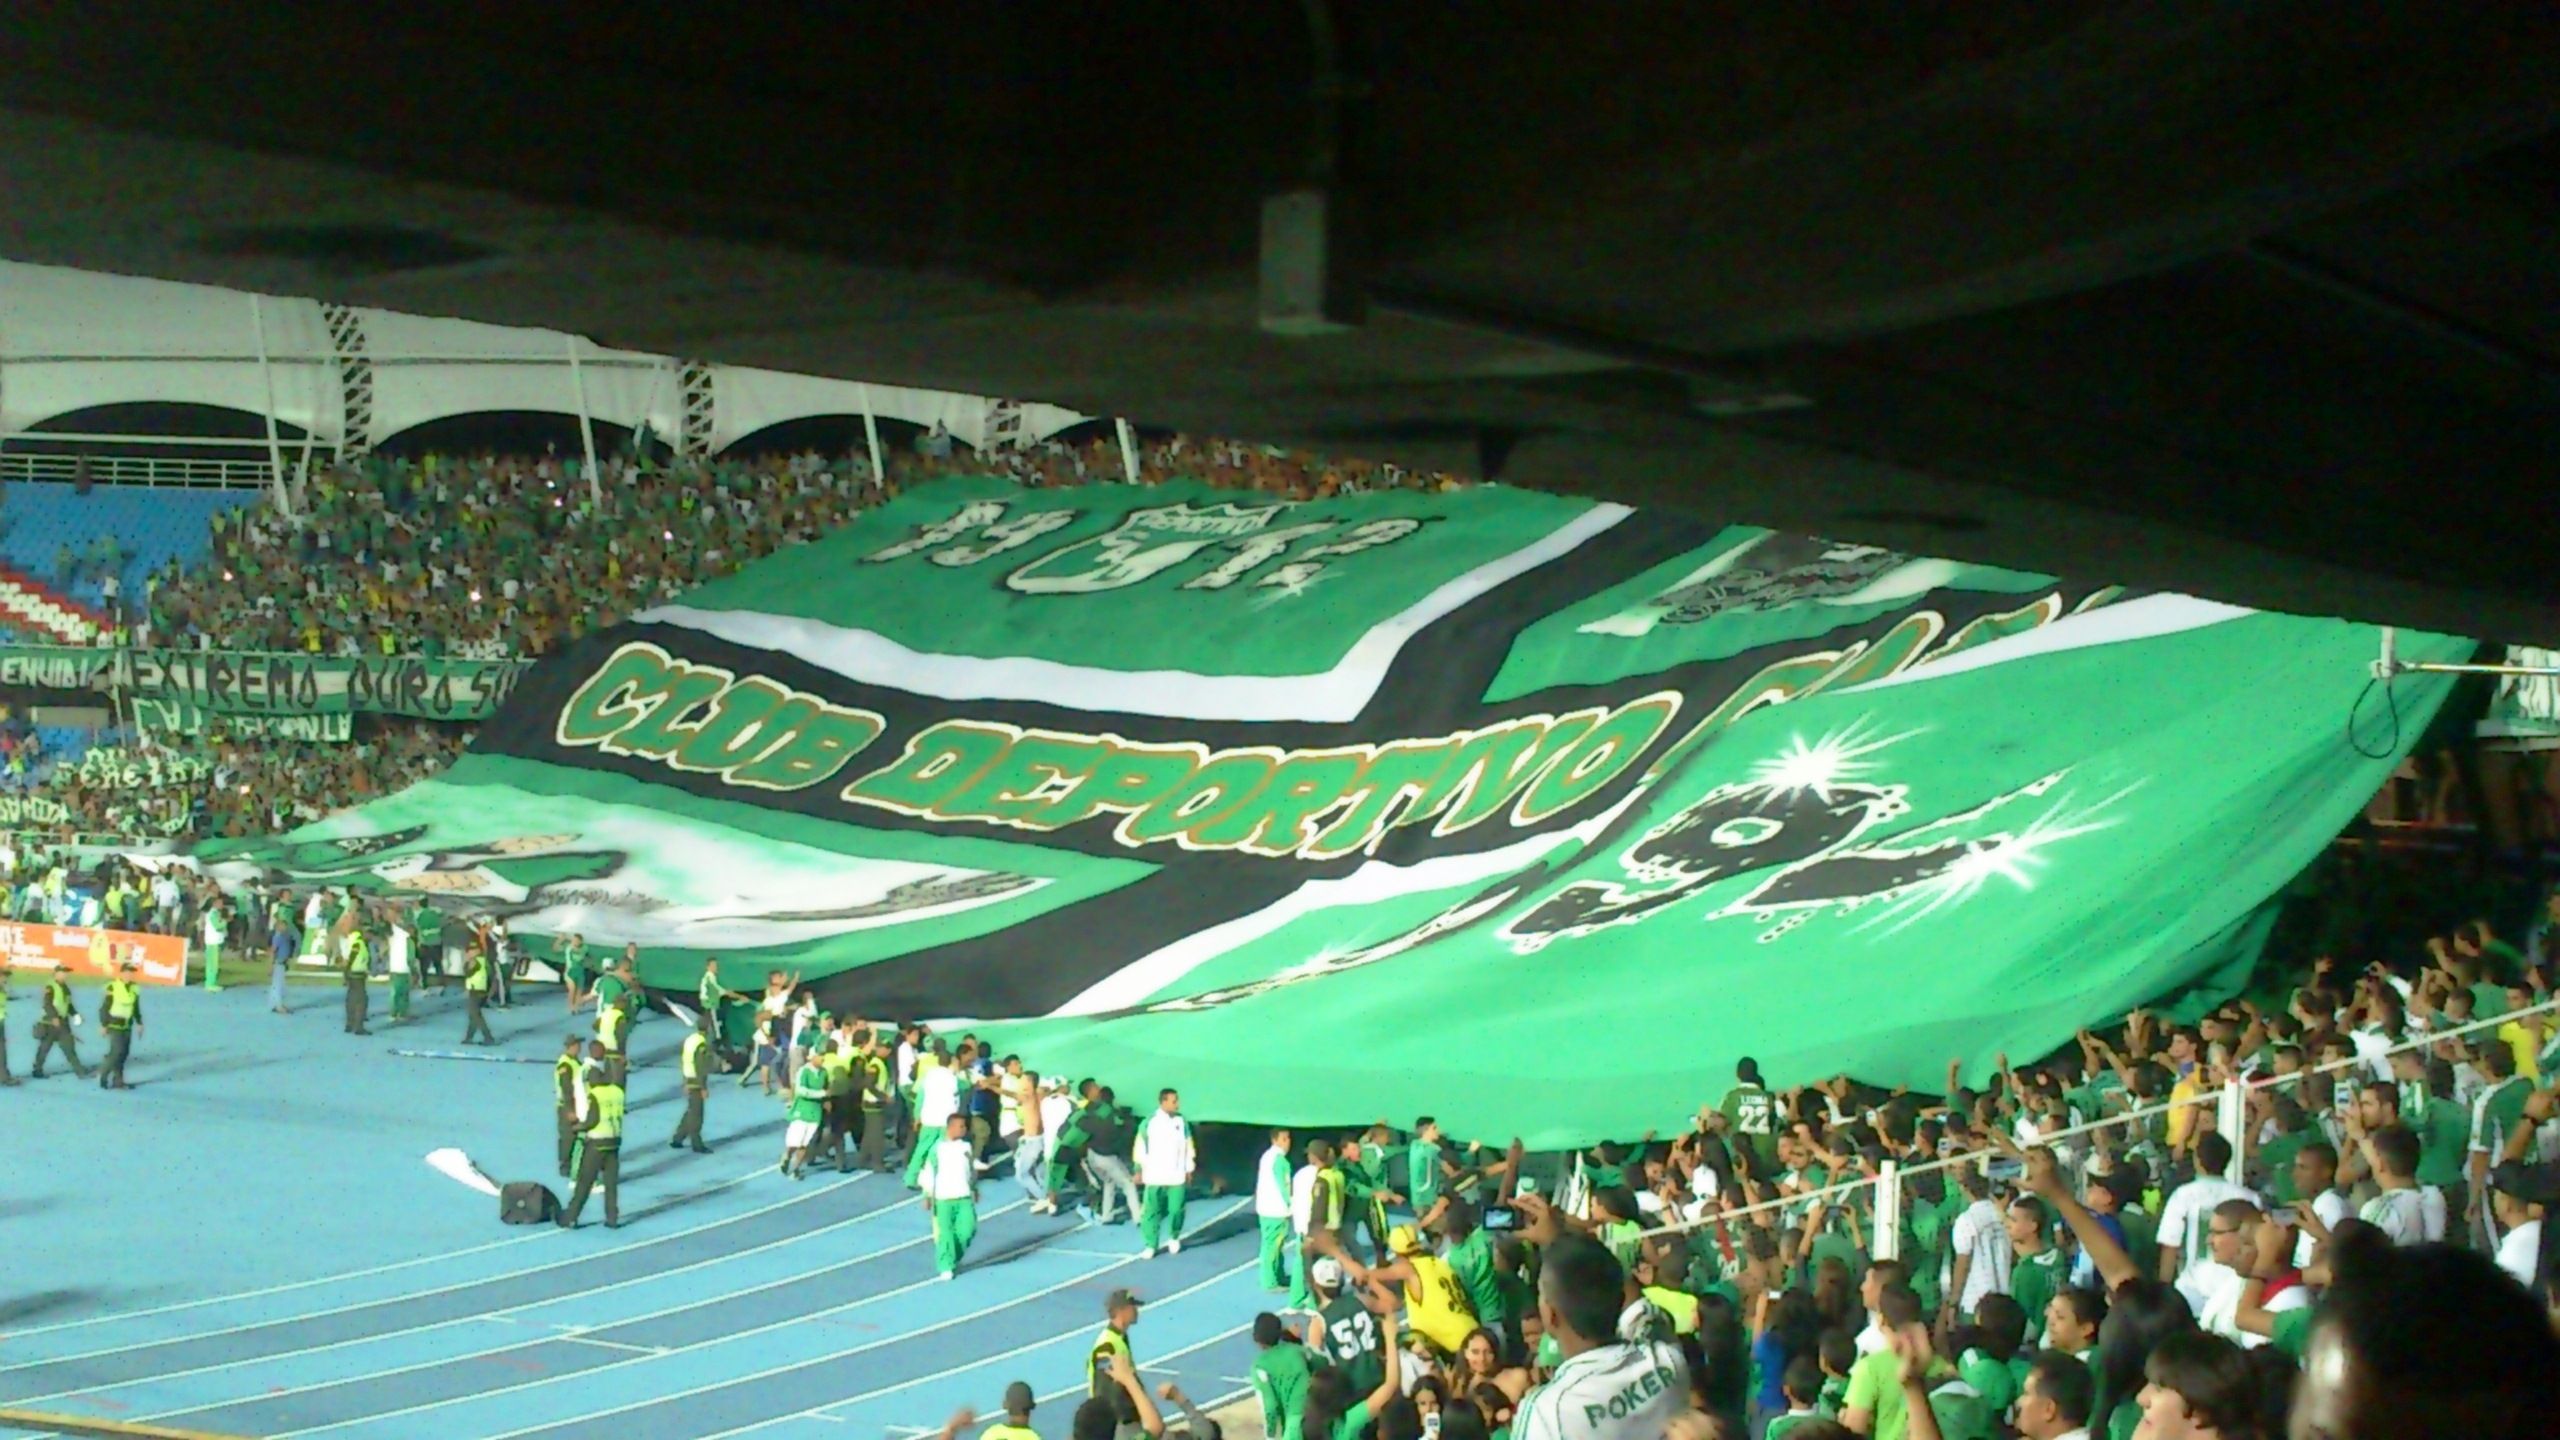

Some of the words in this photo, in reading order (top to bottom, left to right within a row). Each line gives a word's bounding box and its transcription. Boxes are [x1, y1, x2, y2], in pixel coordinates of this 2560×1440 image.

[127, 651, 318, 709] EXTREMO
[557, 641, 887, 791] CLUB
[841, 690, 1683, 861] DEPORTIVO
[1738, 1105, 1770, 1134] 22
[1330, 1310, 1378, 1360] 52
[1583, 1365, 1677, 1429] POKER
